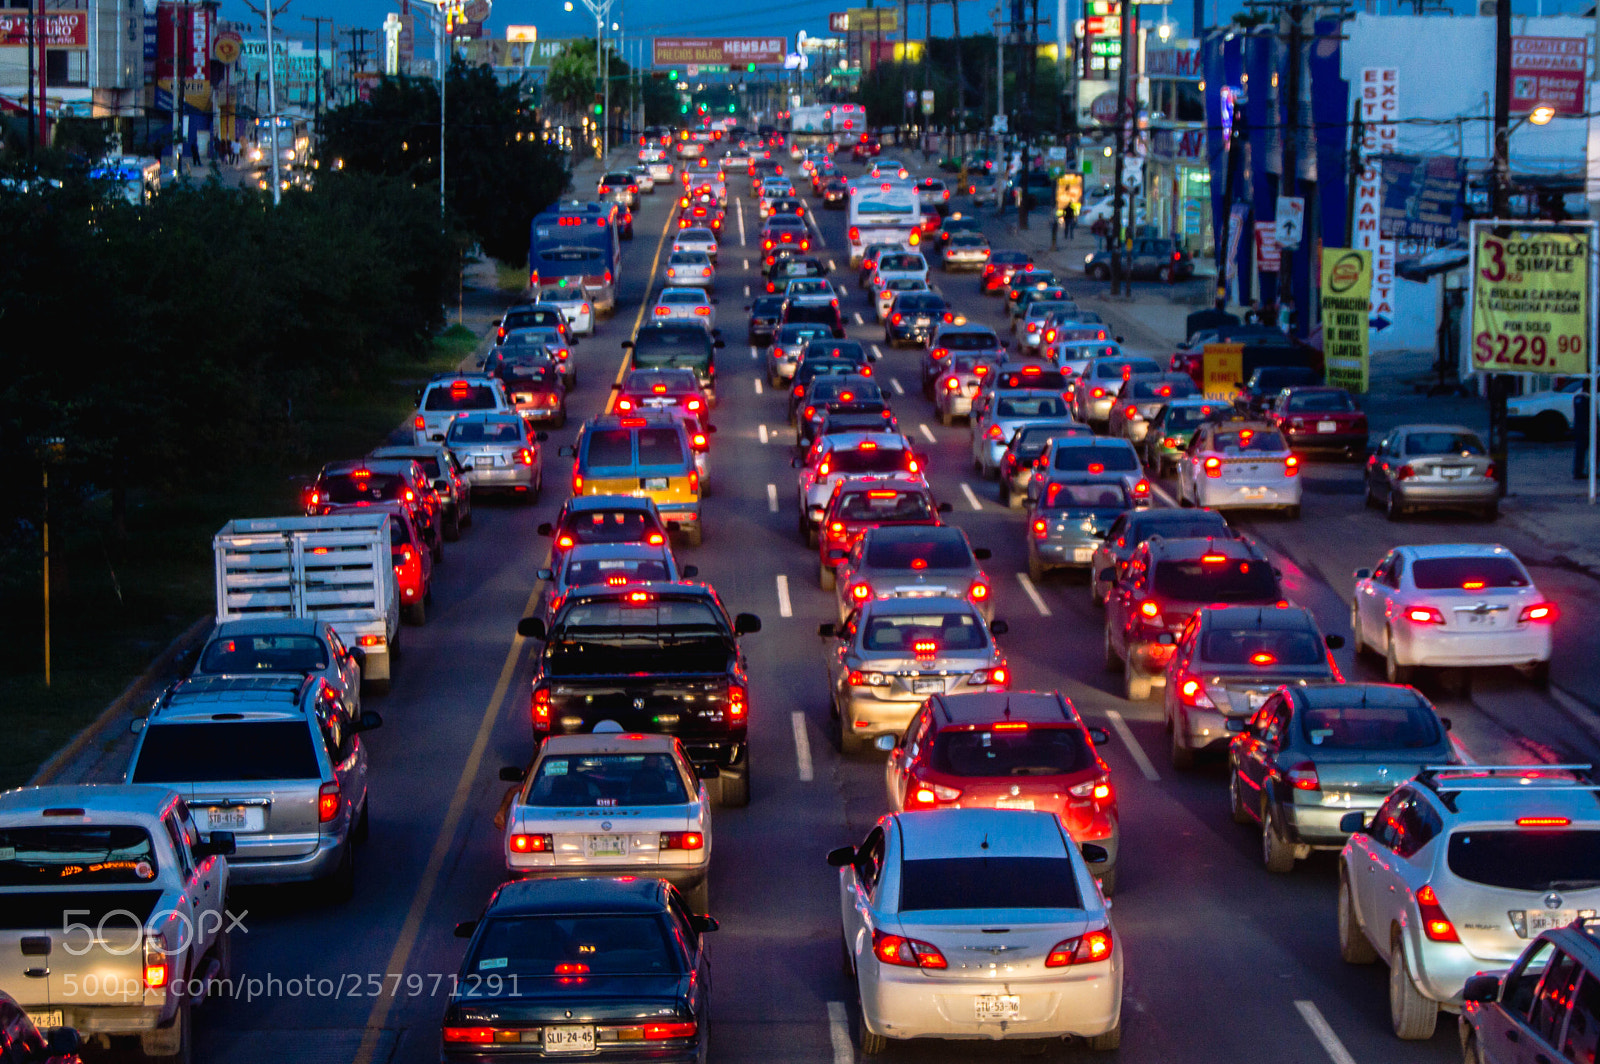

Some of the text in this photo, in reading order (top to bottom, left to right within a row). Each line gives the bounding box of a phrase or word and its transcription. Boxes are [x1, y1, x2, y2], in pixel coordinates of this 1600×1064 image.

[1506, 242, 1584, 256] COSTILLA
[1481, 240, 1506, 282] 3
[1515, 258, 1574, 272] SIMPLE
[546, 1030, 593, 1045] SLU-24-45
